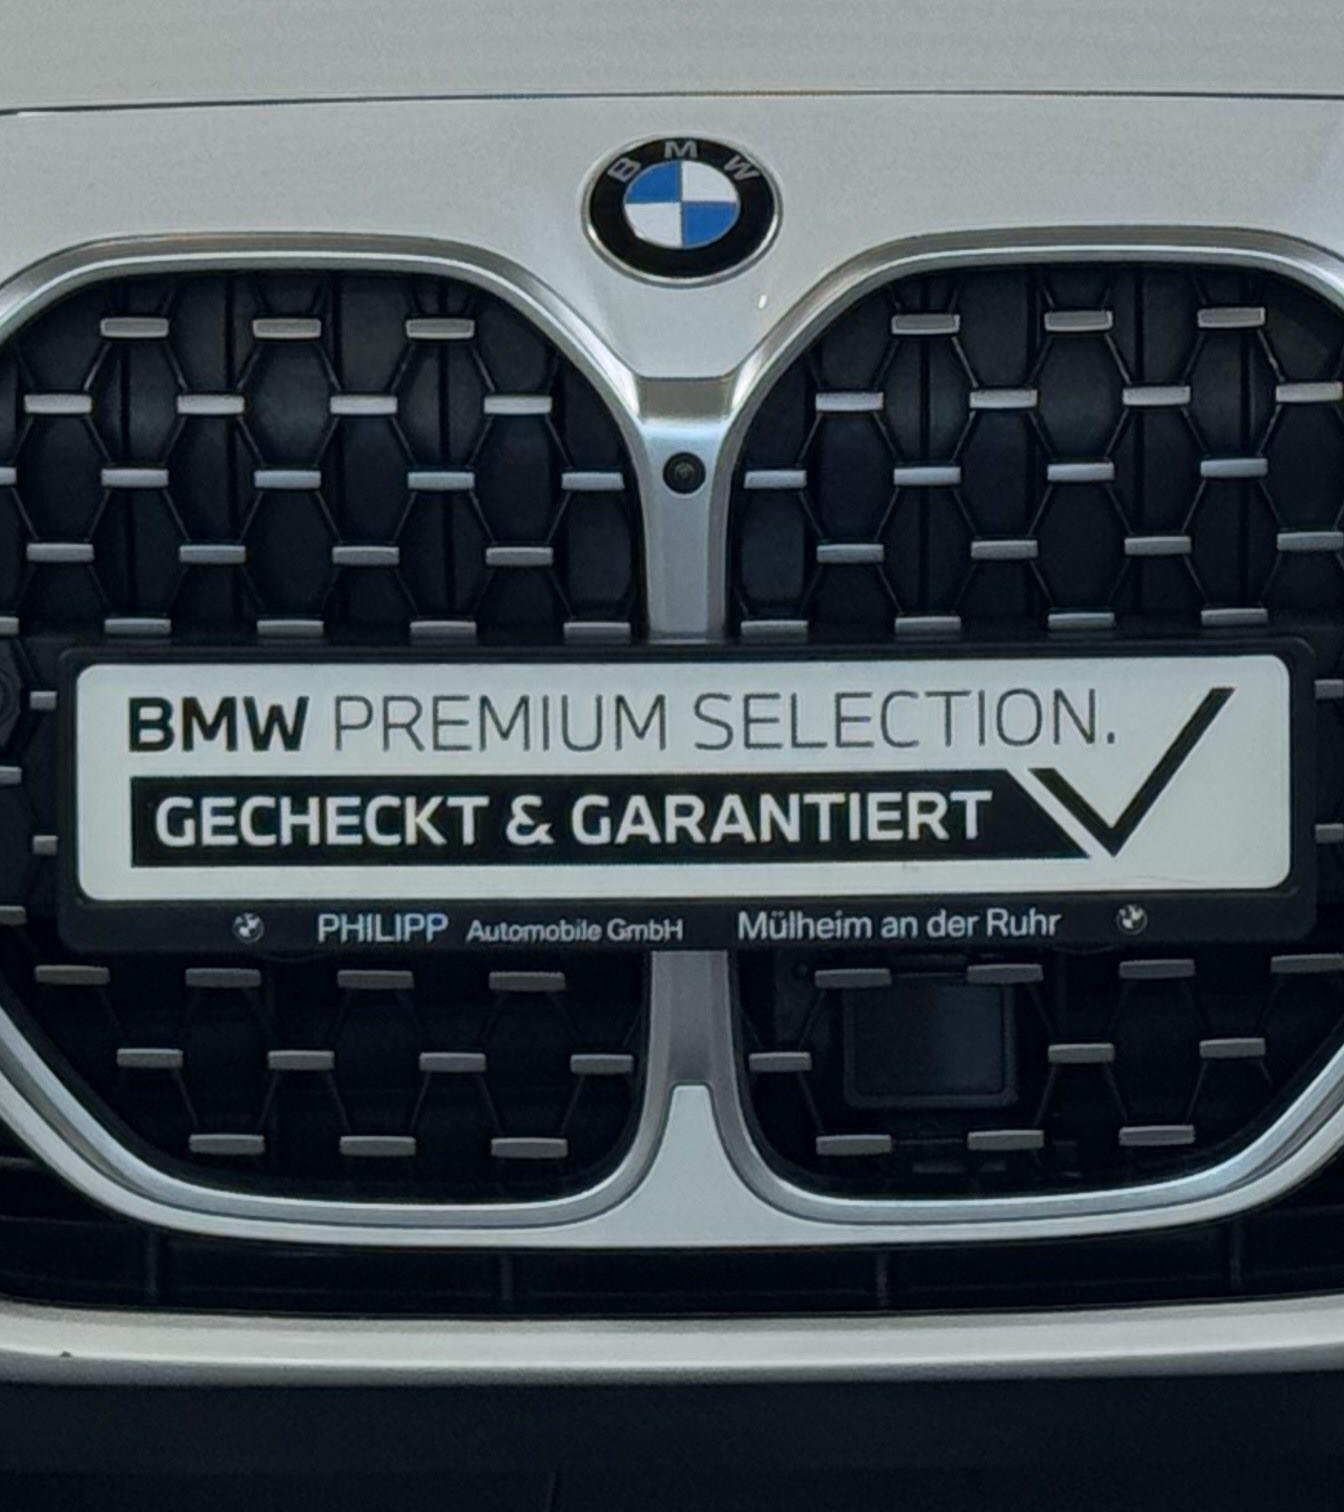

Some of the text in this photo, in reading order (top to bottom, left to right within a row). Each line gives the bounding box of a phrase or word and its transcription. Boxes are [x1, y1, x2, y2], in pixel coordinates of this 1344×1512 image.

[607, 139, 760, 183] BMW
[127, 687, 1117, 754] BMW PREMIUM SELECTION.
[155, 790, 993, 848] GECHECKT & GARANTIERT
[316, 907, 1062, 944] PHILIPP Automobile GmbH Mülheim an der Ruhr
